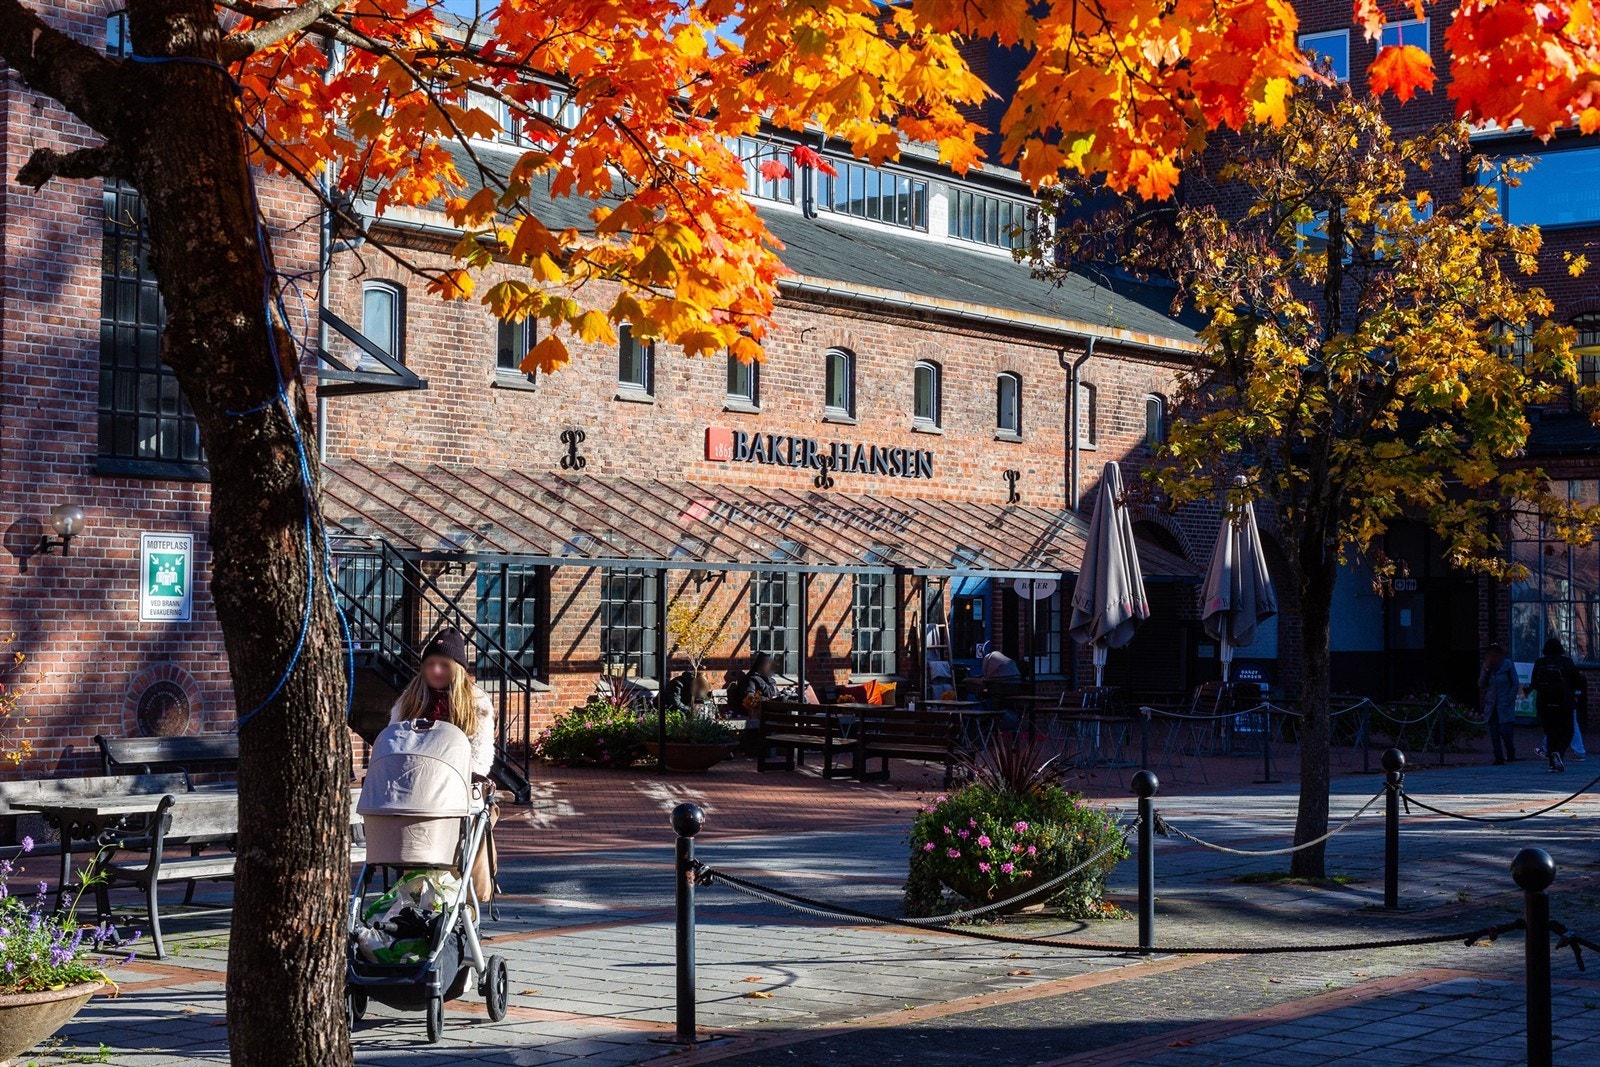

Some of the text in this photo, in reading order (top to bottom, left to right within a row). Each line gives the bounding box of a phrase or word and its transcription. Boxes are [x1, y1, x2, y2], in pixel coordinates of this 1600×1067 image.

[732, 430, 933, 478] BAKER HANSEN
[146, 540, 188, 550] MØTEPLASS
[149, 608, 182, 616] EVAKUERING
